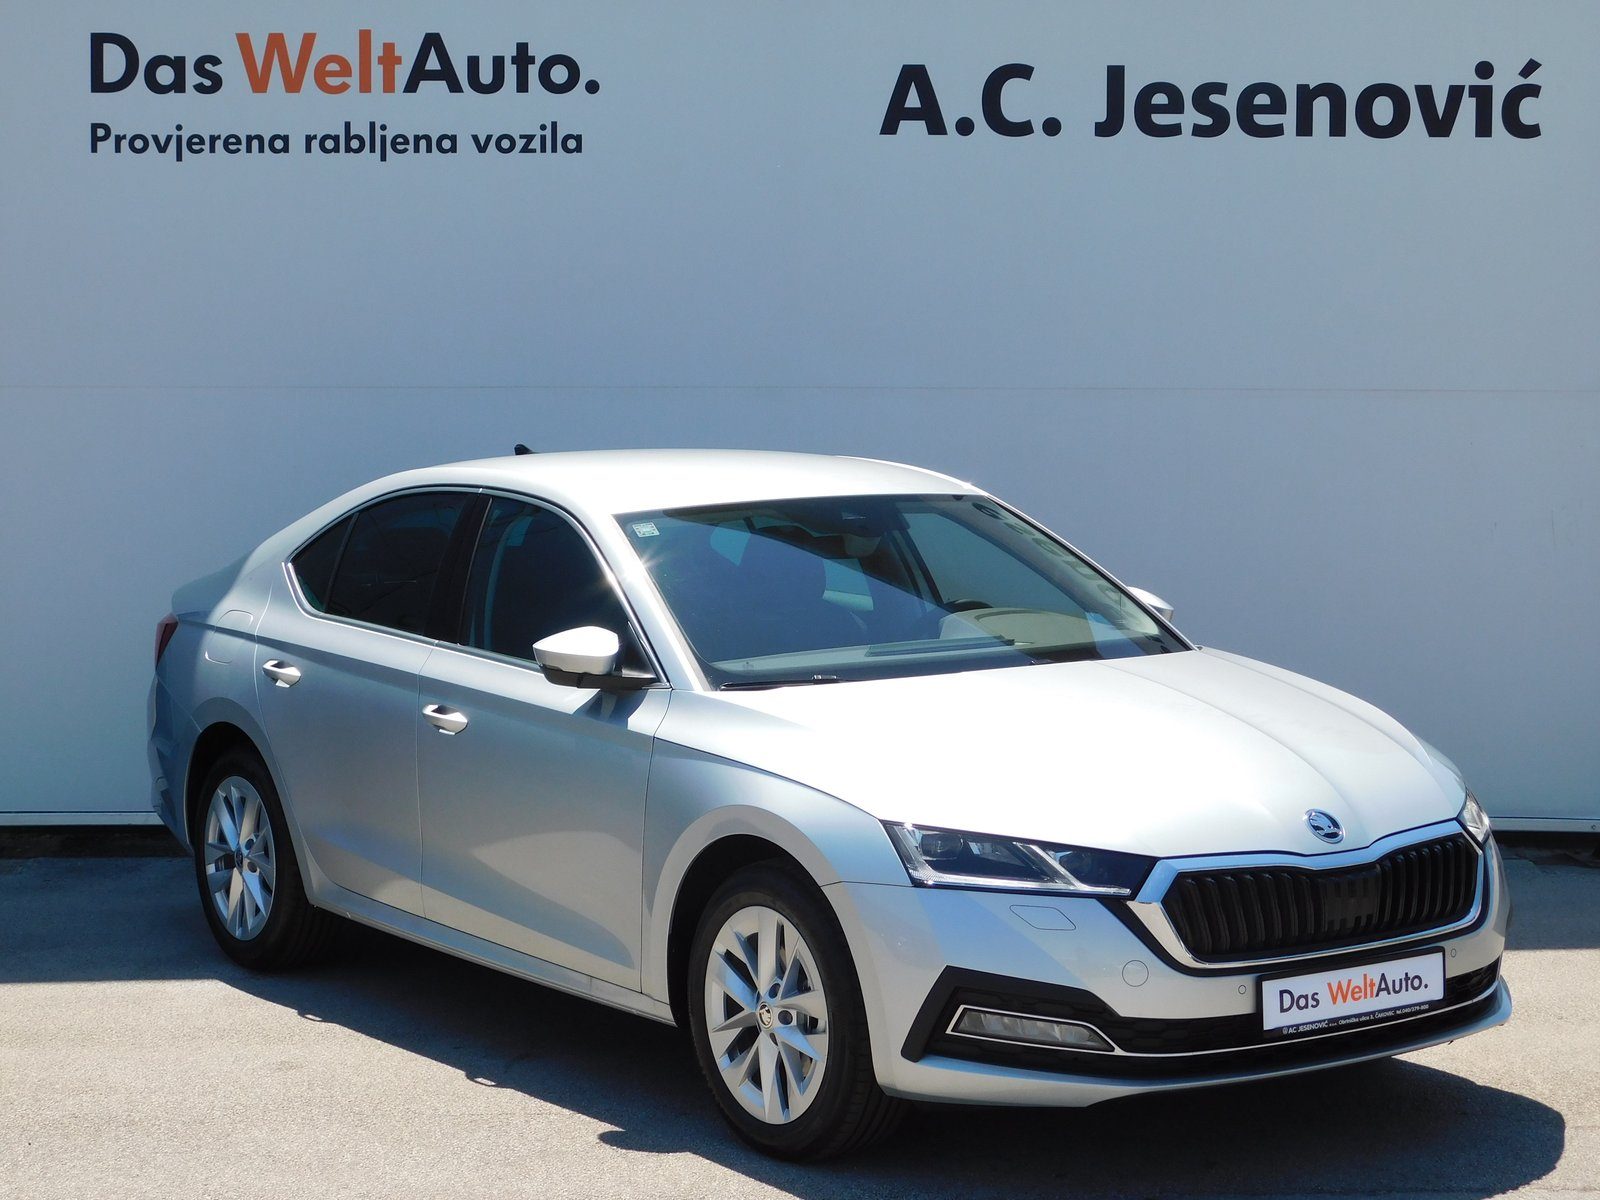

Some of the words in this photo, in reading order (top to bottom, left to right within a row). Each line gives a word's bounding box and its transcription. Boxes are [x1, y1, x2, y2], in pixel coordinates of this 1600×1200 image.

[91, 33, 222, 95] Das
[236, 29, 600, 95] WeltAuto.
[880, 63, 1061, 137] A.C.
[1095, 58, 1542, 139] Jesenović
[91, 123, 289, 162] Provjerena
[305, 121, 457, 162] rabljena
[471, 121, 583, 154] vozila
[1279, 989, 1320, 1014] Das
[1327, 972, 1429, 1005] WeltAuto.
[1298, 1020, 1329, 1033] JESENOVIĆ
